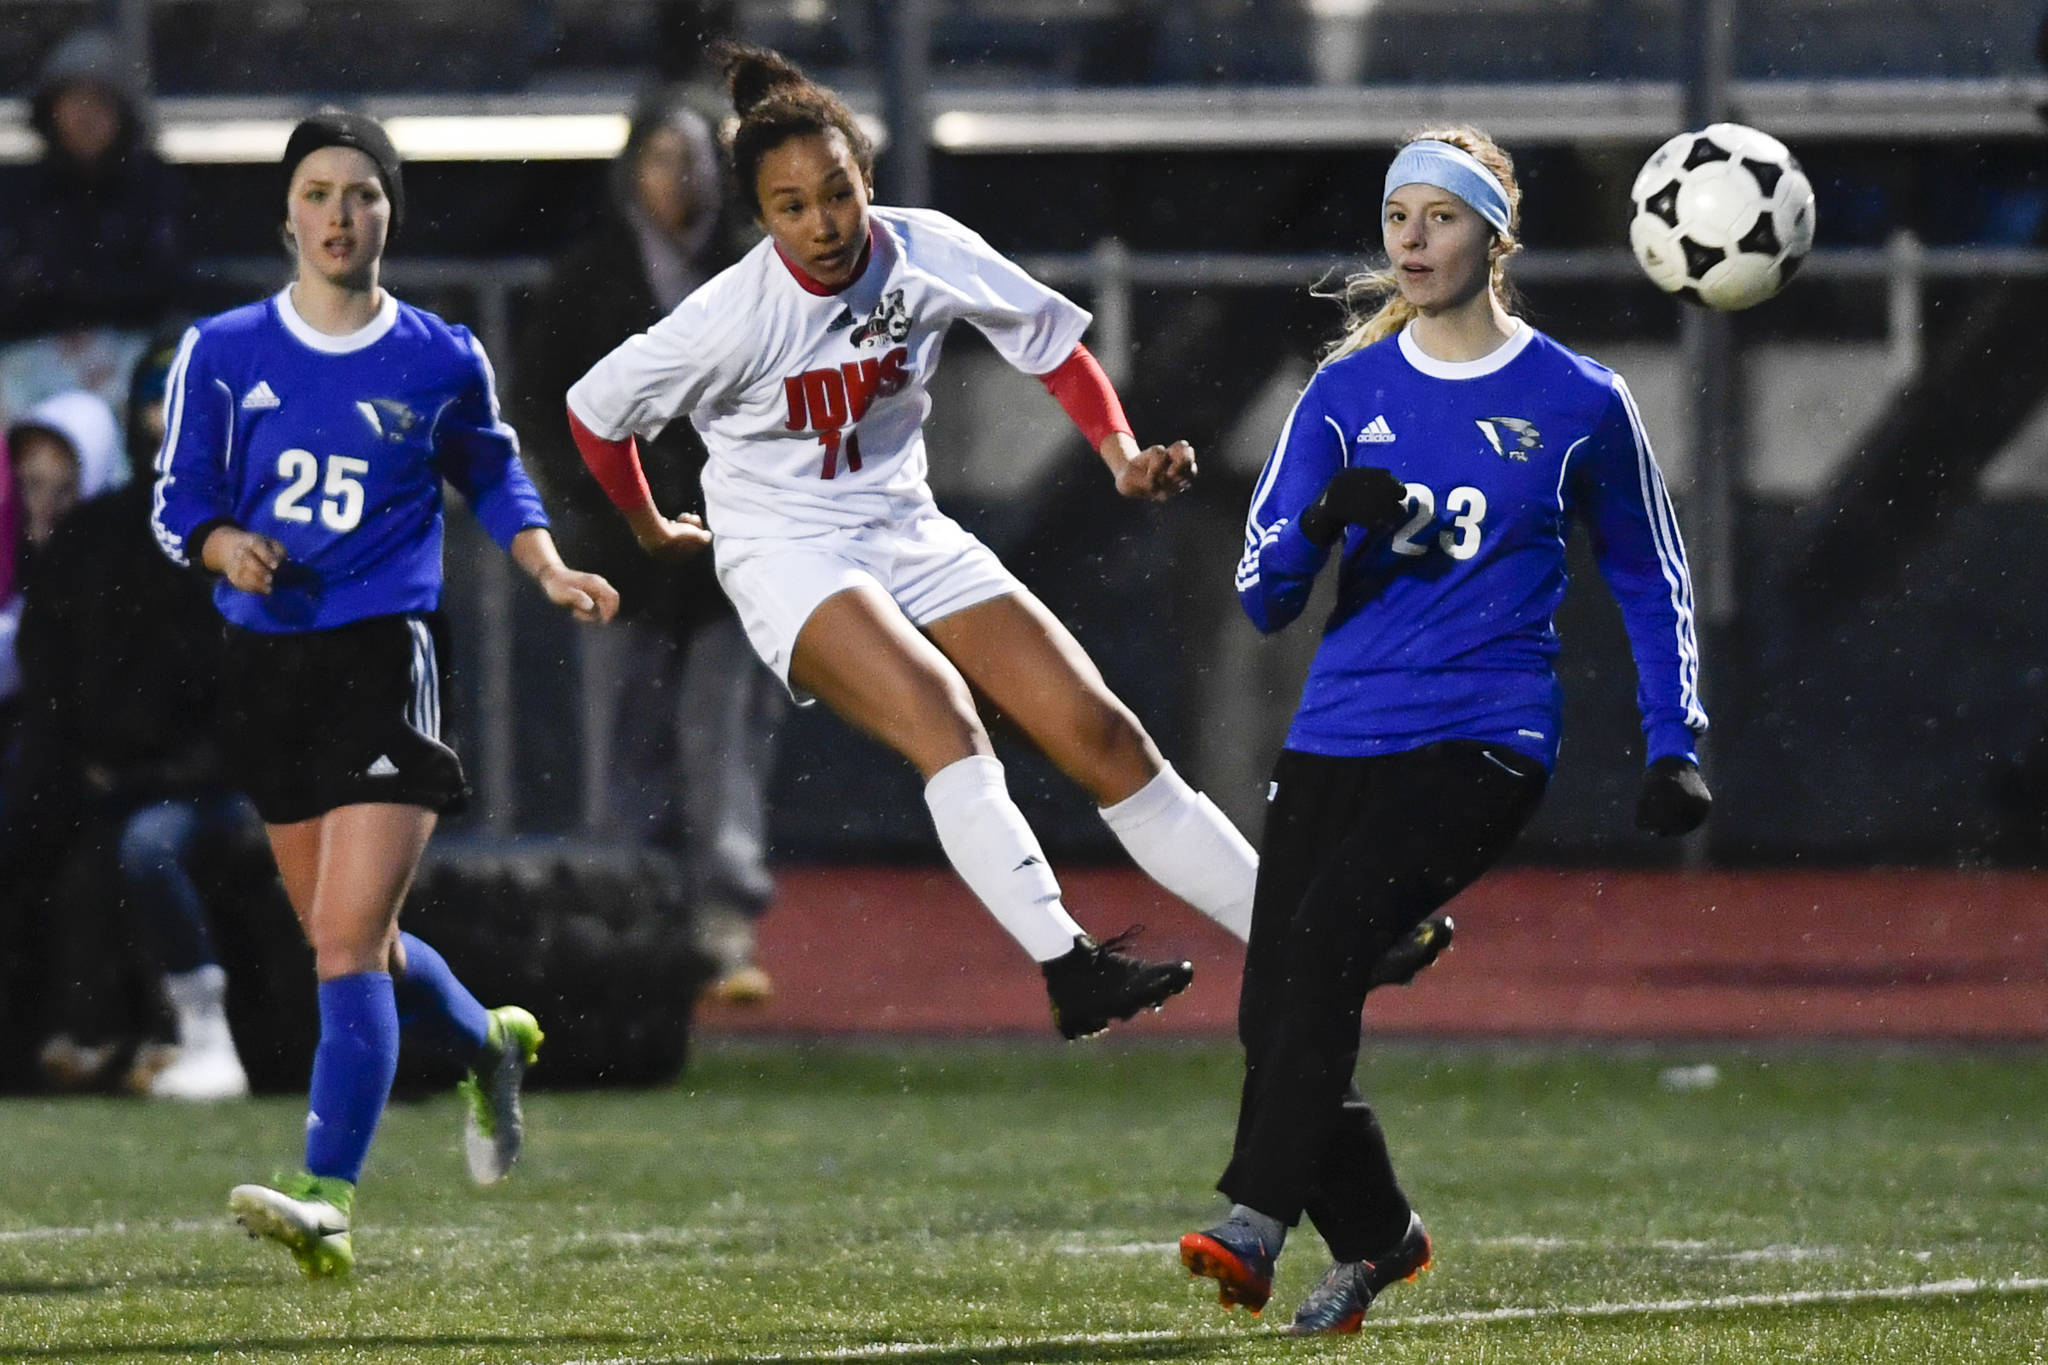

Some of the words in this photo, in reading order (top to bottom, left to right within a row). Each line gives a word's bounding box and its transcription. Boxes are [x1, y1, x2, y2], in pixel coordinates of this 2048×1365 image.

[784, 347, 910, 431] JDHS
[273, 448, 369, 532] 25
[1391, 482, 1487, 560] 23
